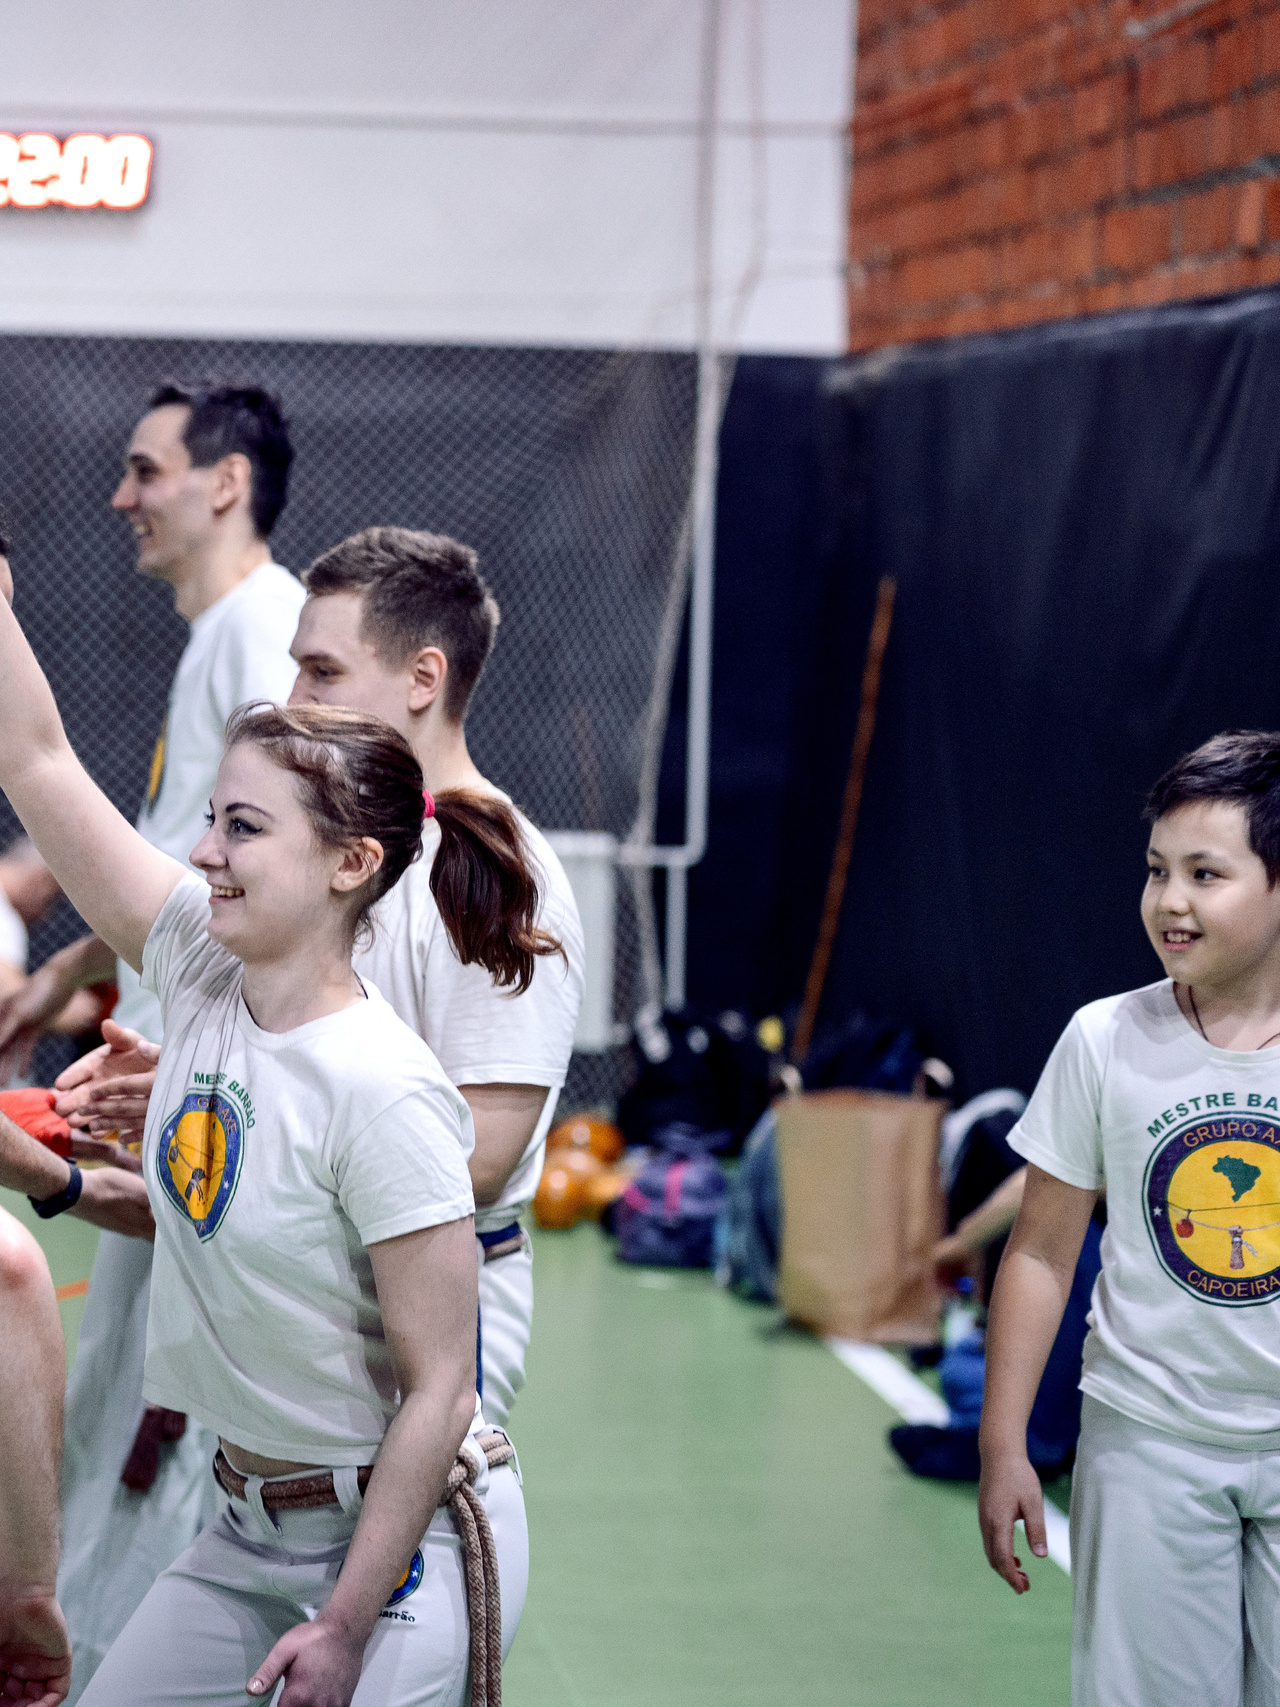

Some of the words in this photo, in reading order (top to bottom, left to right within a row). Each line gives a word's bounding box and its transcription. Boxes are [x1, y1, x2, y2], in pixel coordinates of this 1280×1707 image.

[227, 1079, 256, 1129] BARRÃO
[1147, 1092, 1236, 1138] MESTRE
[1183, 1121, 1257, 1148] GRUPO
[1187, 1270, 1280, 1297] CAPOEIRA
